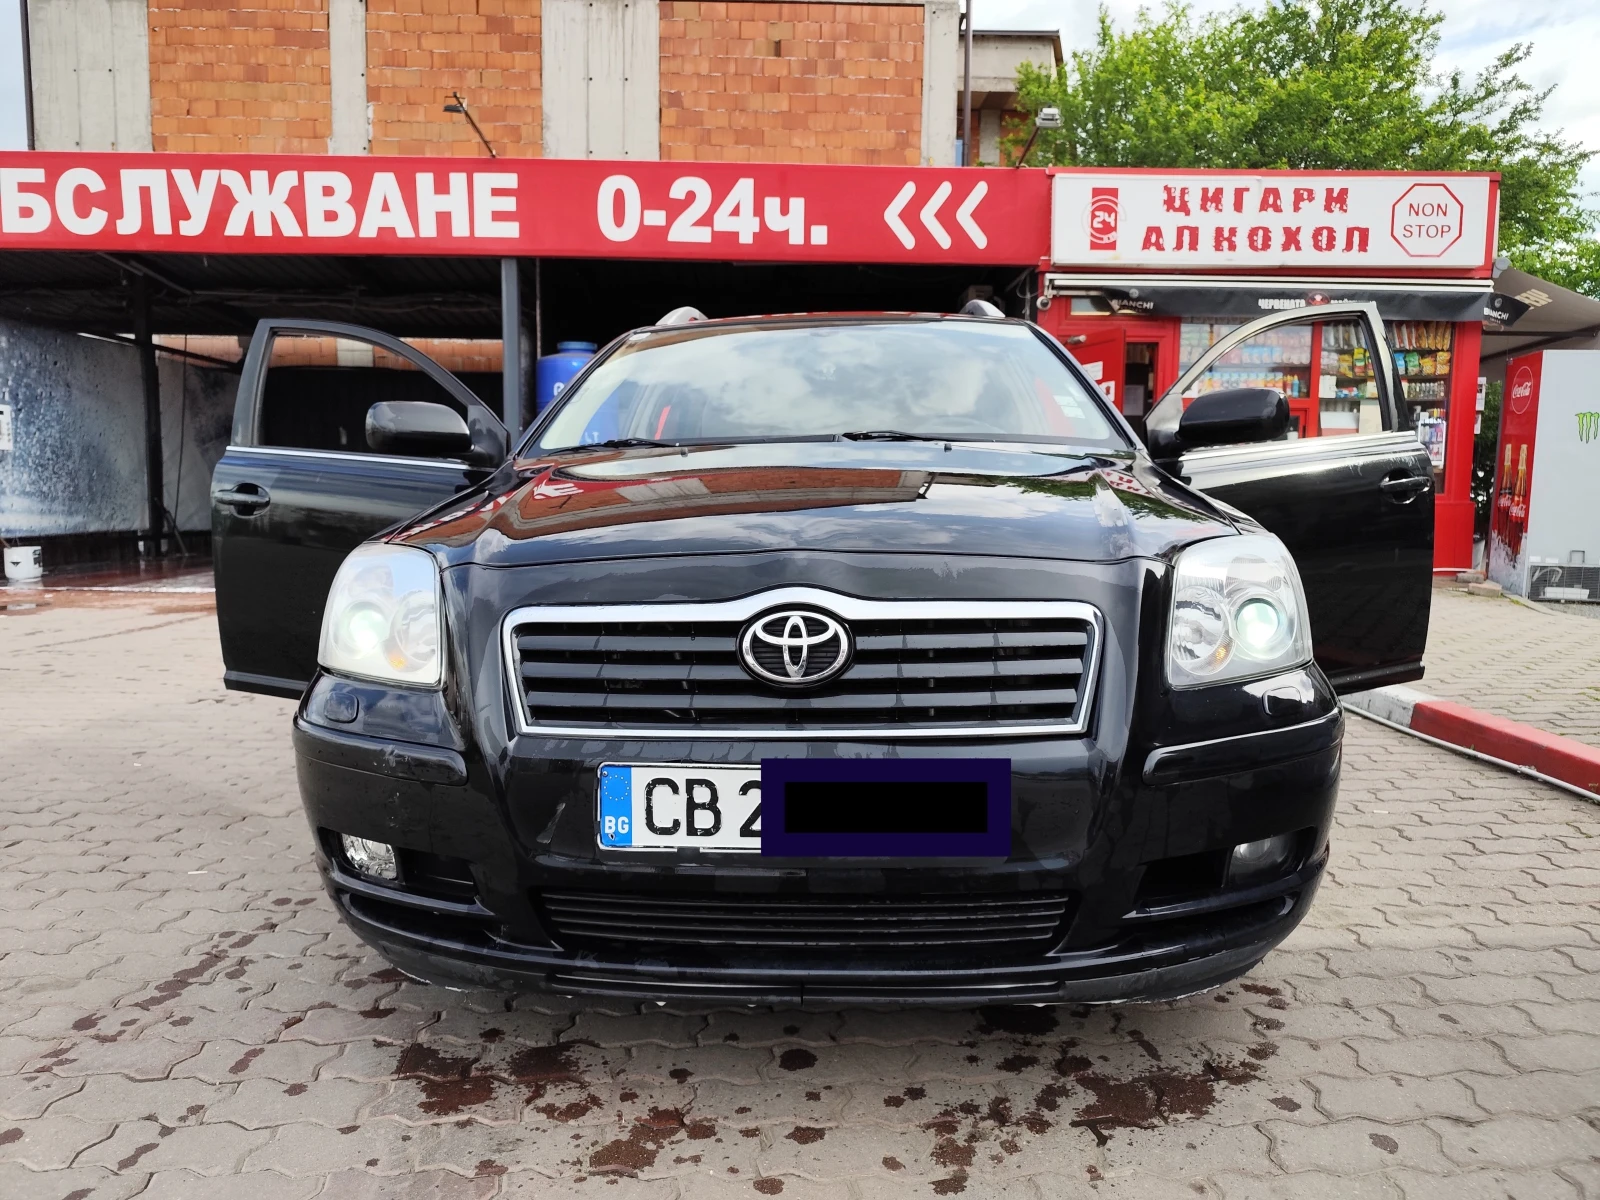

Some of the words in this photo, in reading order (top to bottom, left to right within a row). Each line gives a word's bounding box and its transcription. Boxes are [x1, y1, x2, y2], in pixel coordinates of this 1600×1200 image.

[0, 167, 520, 239] БСЛУЖВАНЕ
[597, 174, 828, 245] 0-24ч.
[1163, 184, 1349, 217] ЦИГАРИ
[1408, 202, 1448, 217] NON
[1092, 210, 1116, 228] 24
[1141, 225, 1370, 252] АЛКОХОЛ
[1402, 224, 1451, 239] STOP
[604, 815, 629, 834] BG
